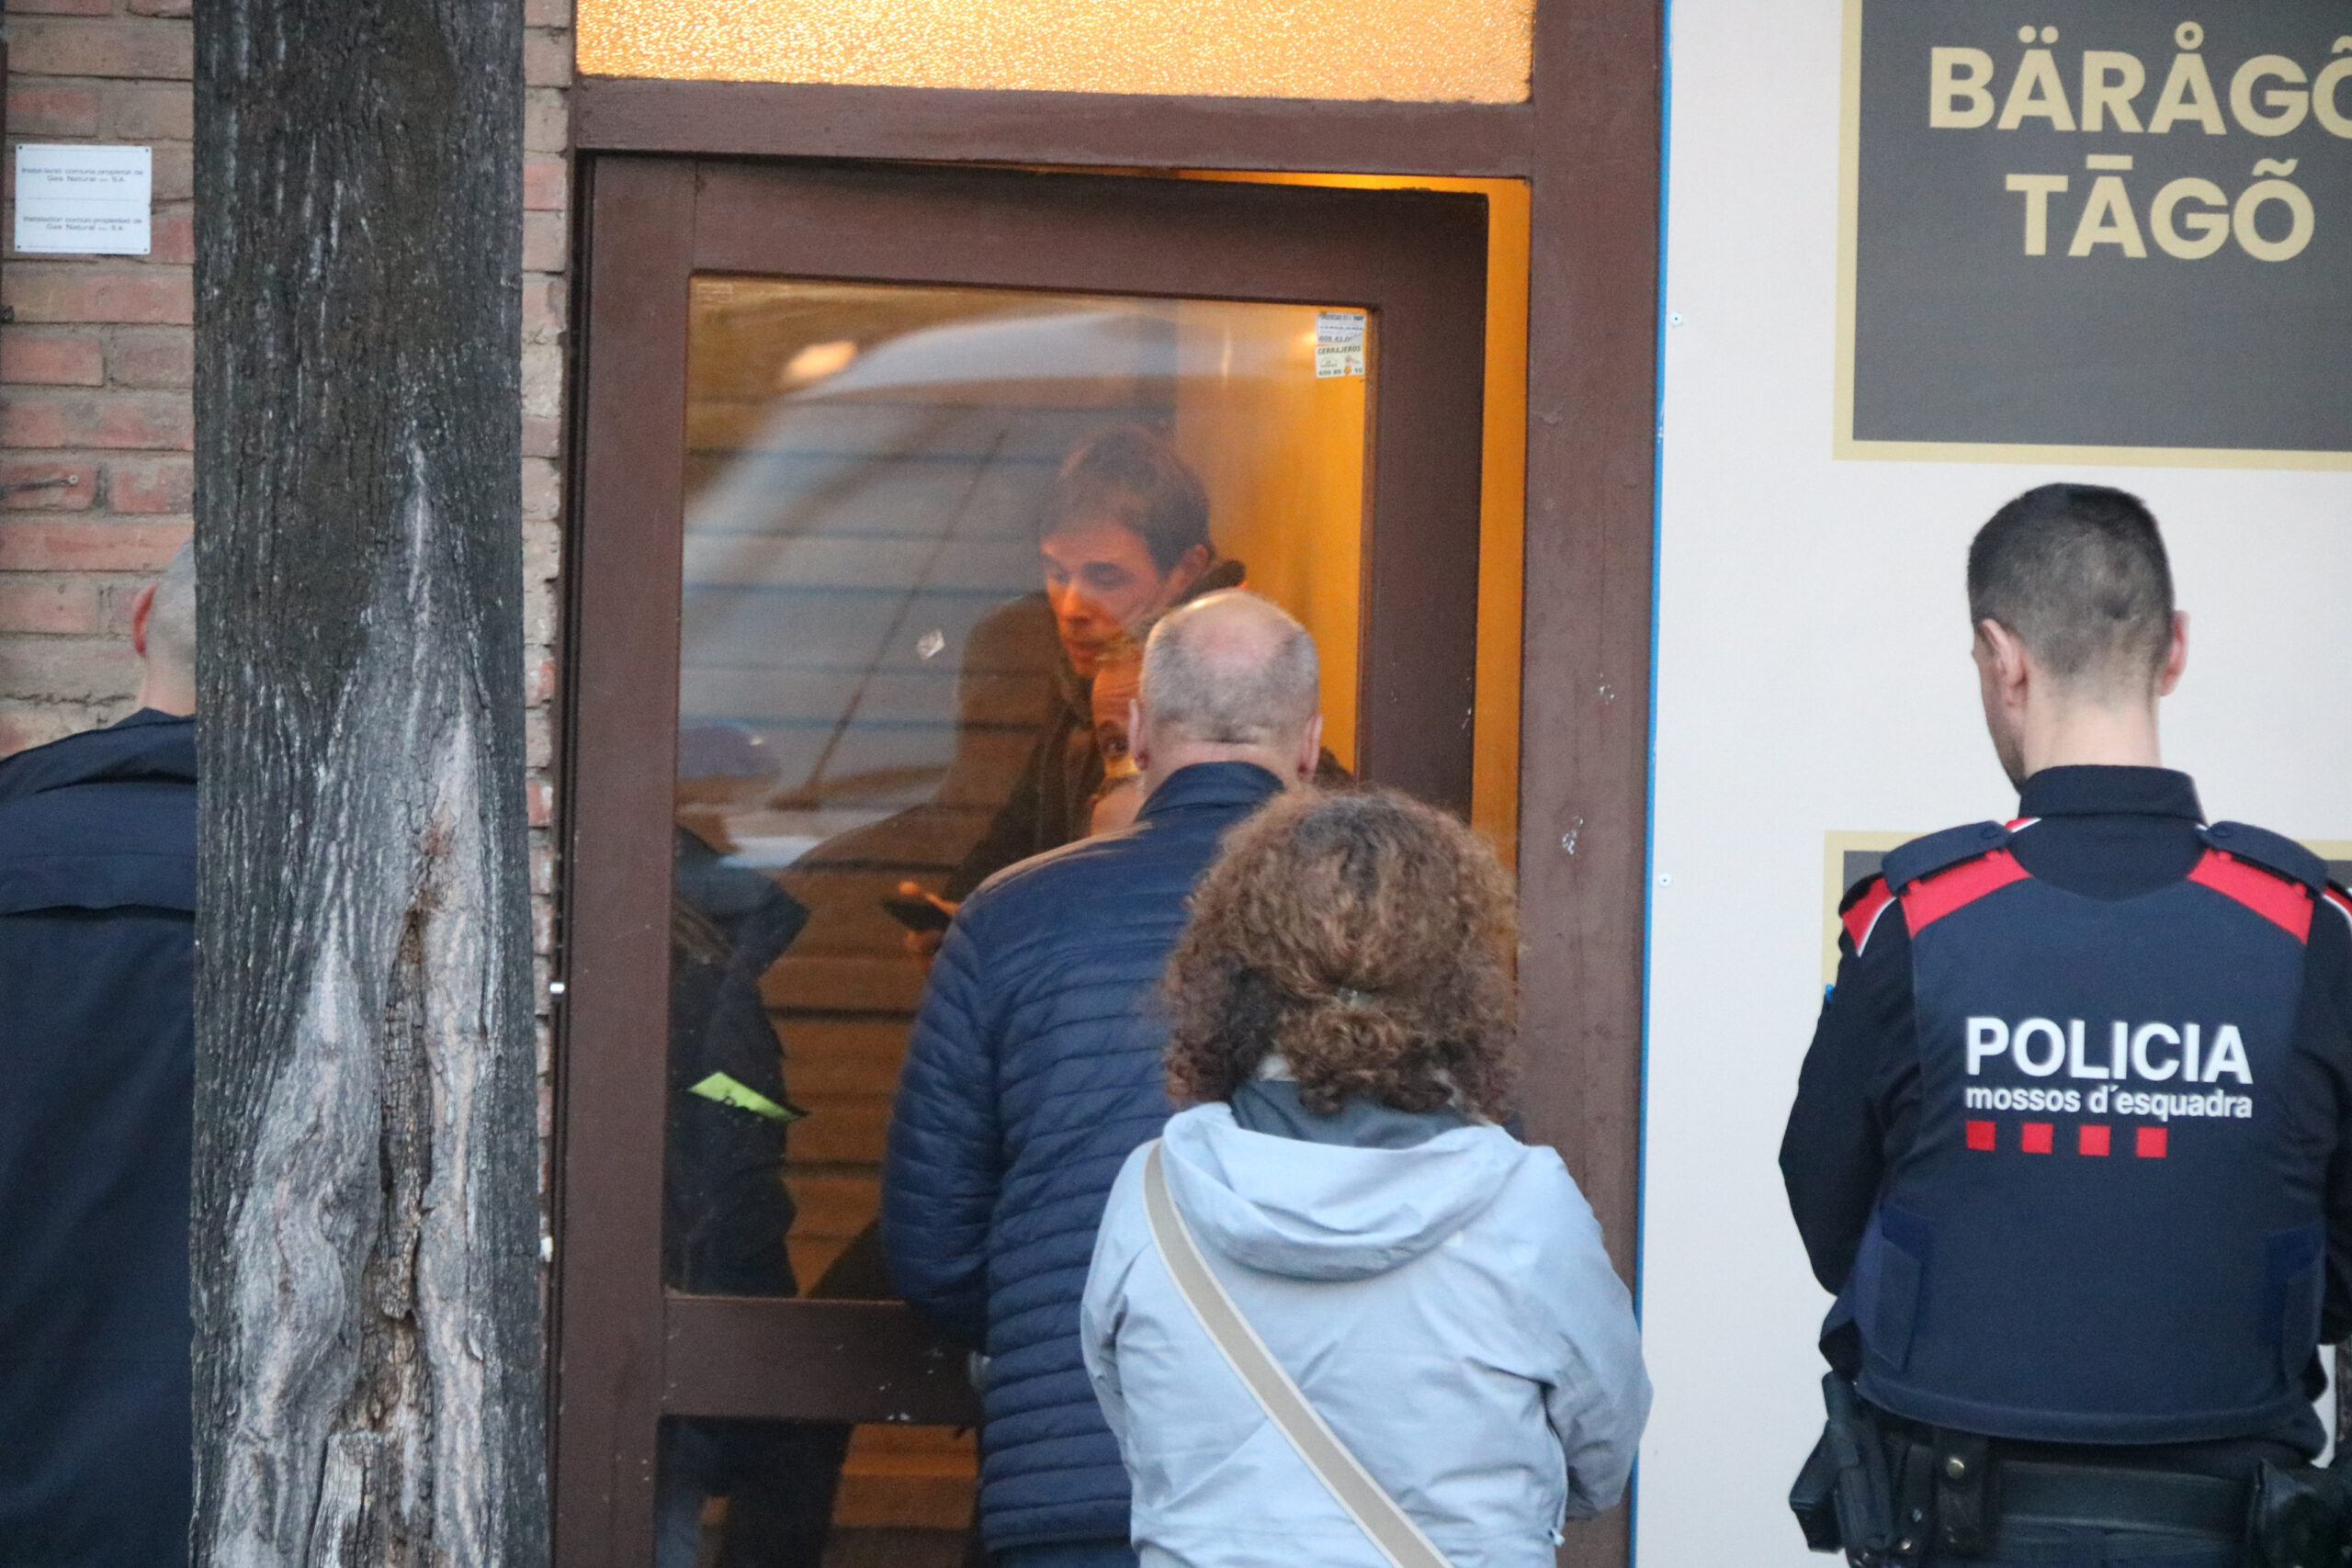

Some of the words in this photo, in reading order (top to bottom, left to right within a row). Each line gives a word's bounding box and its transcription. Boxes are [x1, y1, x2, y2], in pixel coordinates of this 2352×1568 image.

[2006, 154, 2315, 263] TĀGÕ
[1317, 345, 1362, 355] CERRAJEROS
[1965, 1016, 2254, 1085] POLICIA
[1965, 1086, 2081, 1113] mossos
